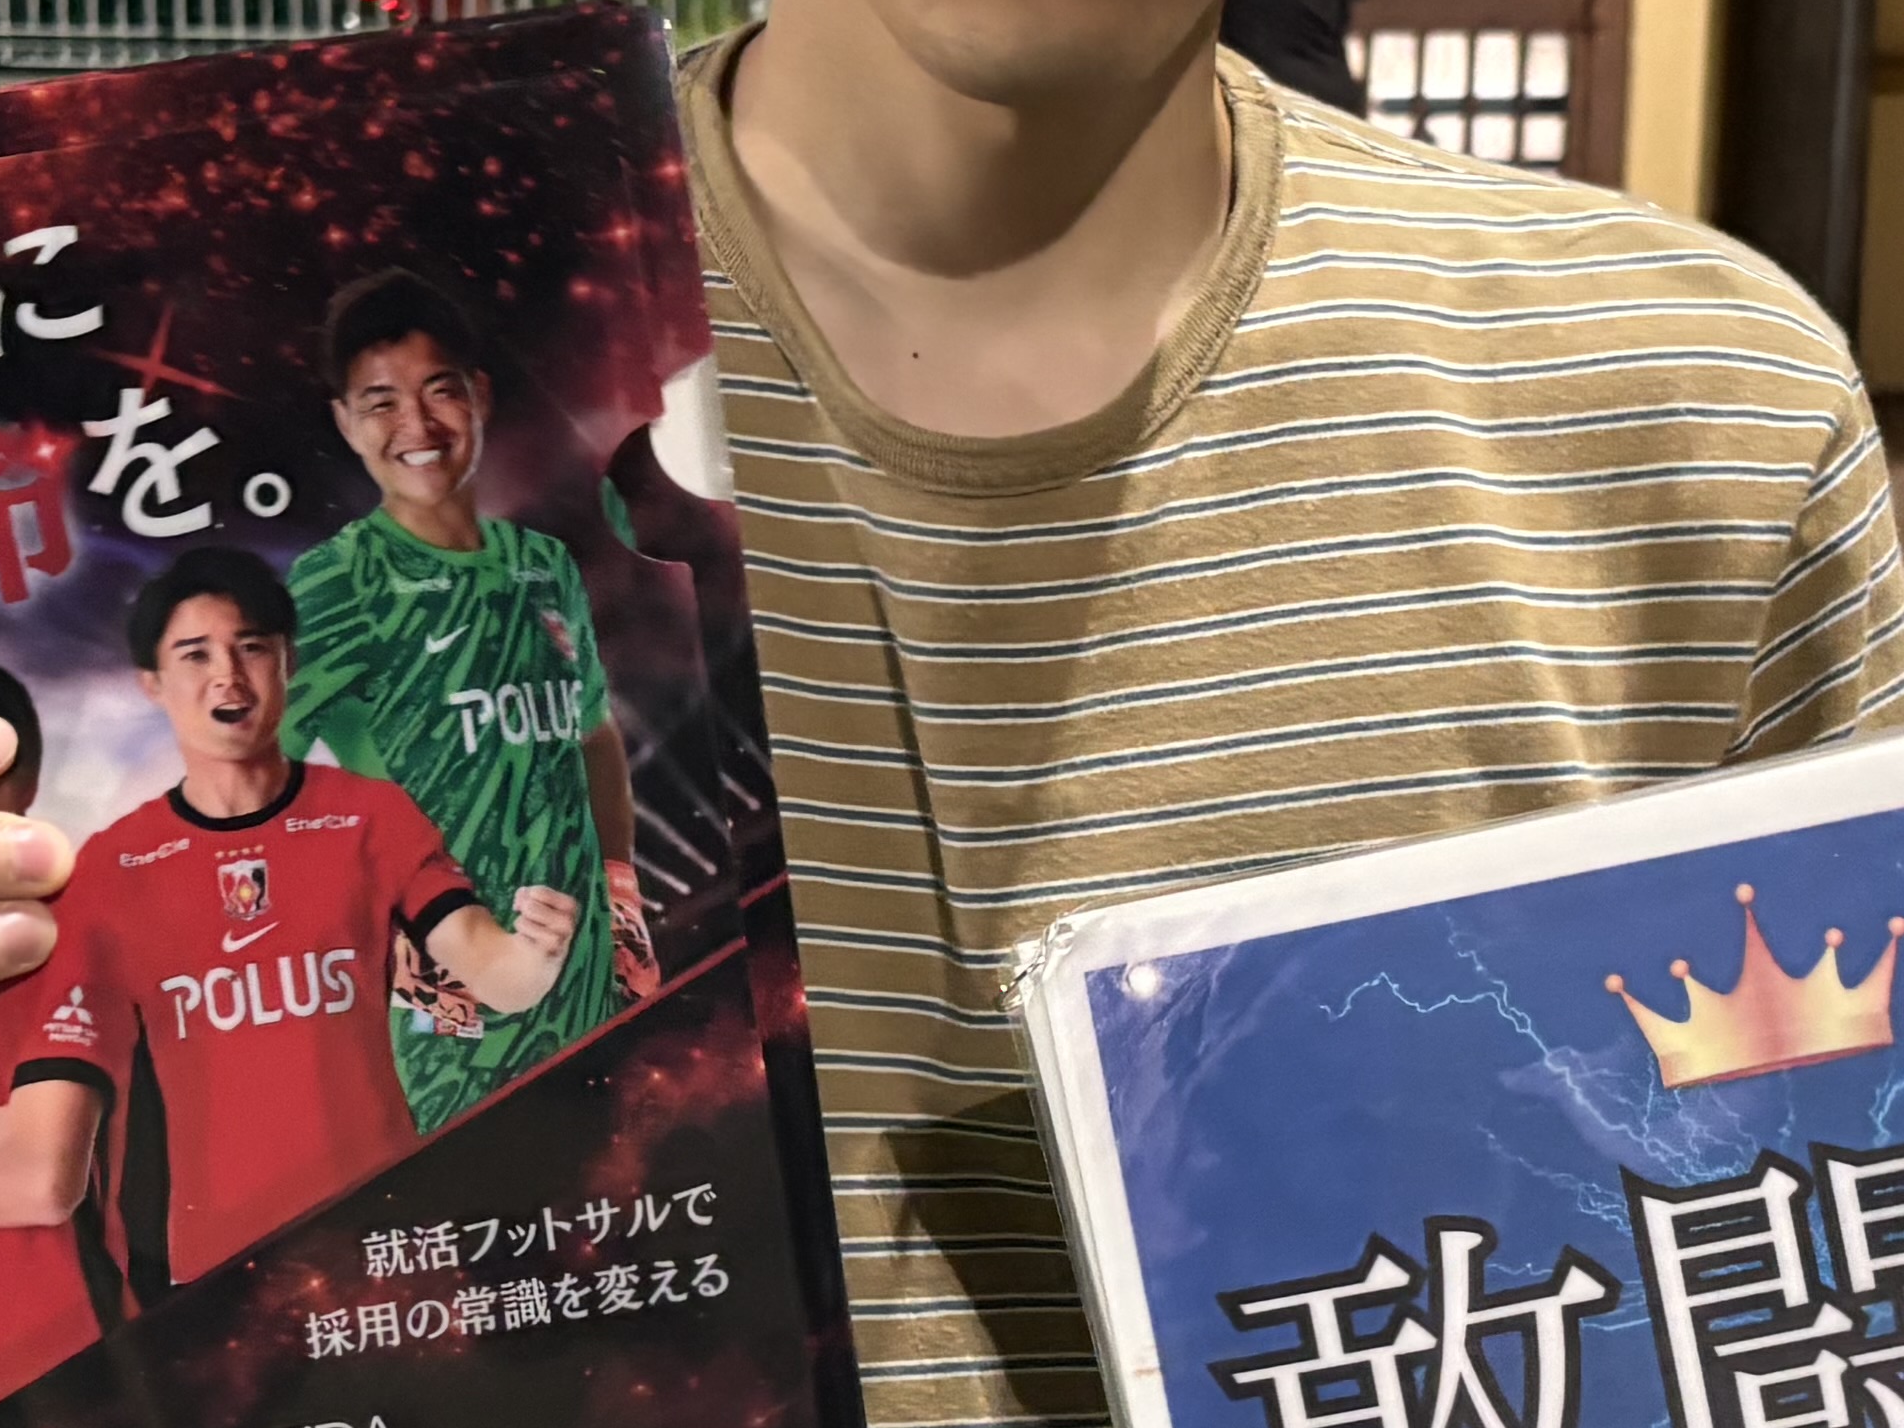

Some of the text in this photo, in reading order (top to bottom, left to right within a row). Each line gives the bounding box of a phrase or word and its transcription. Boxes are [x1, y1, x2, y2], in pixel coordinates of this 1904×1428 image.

[160, 948, 356, 1040] POLUS
[361, 1183, 717, 1278] 就活フットサルで
[305, 1253, 729, 1360] 採用の常識を変える
